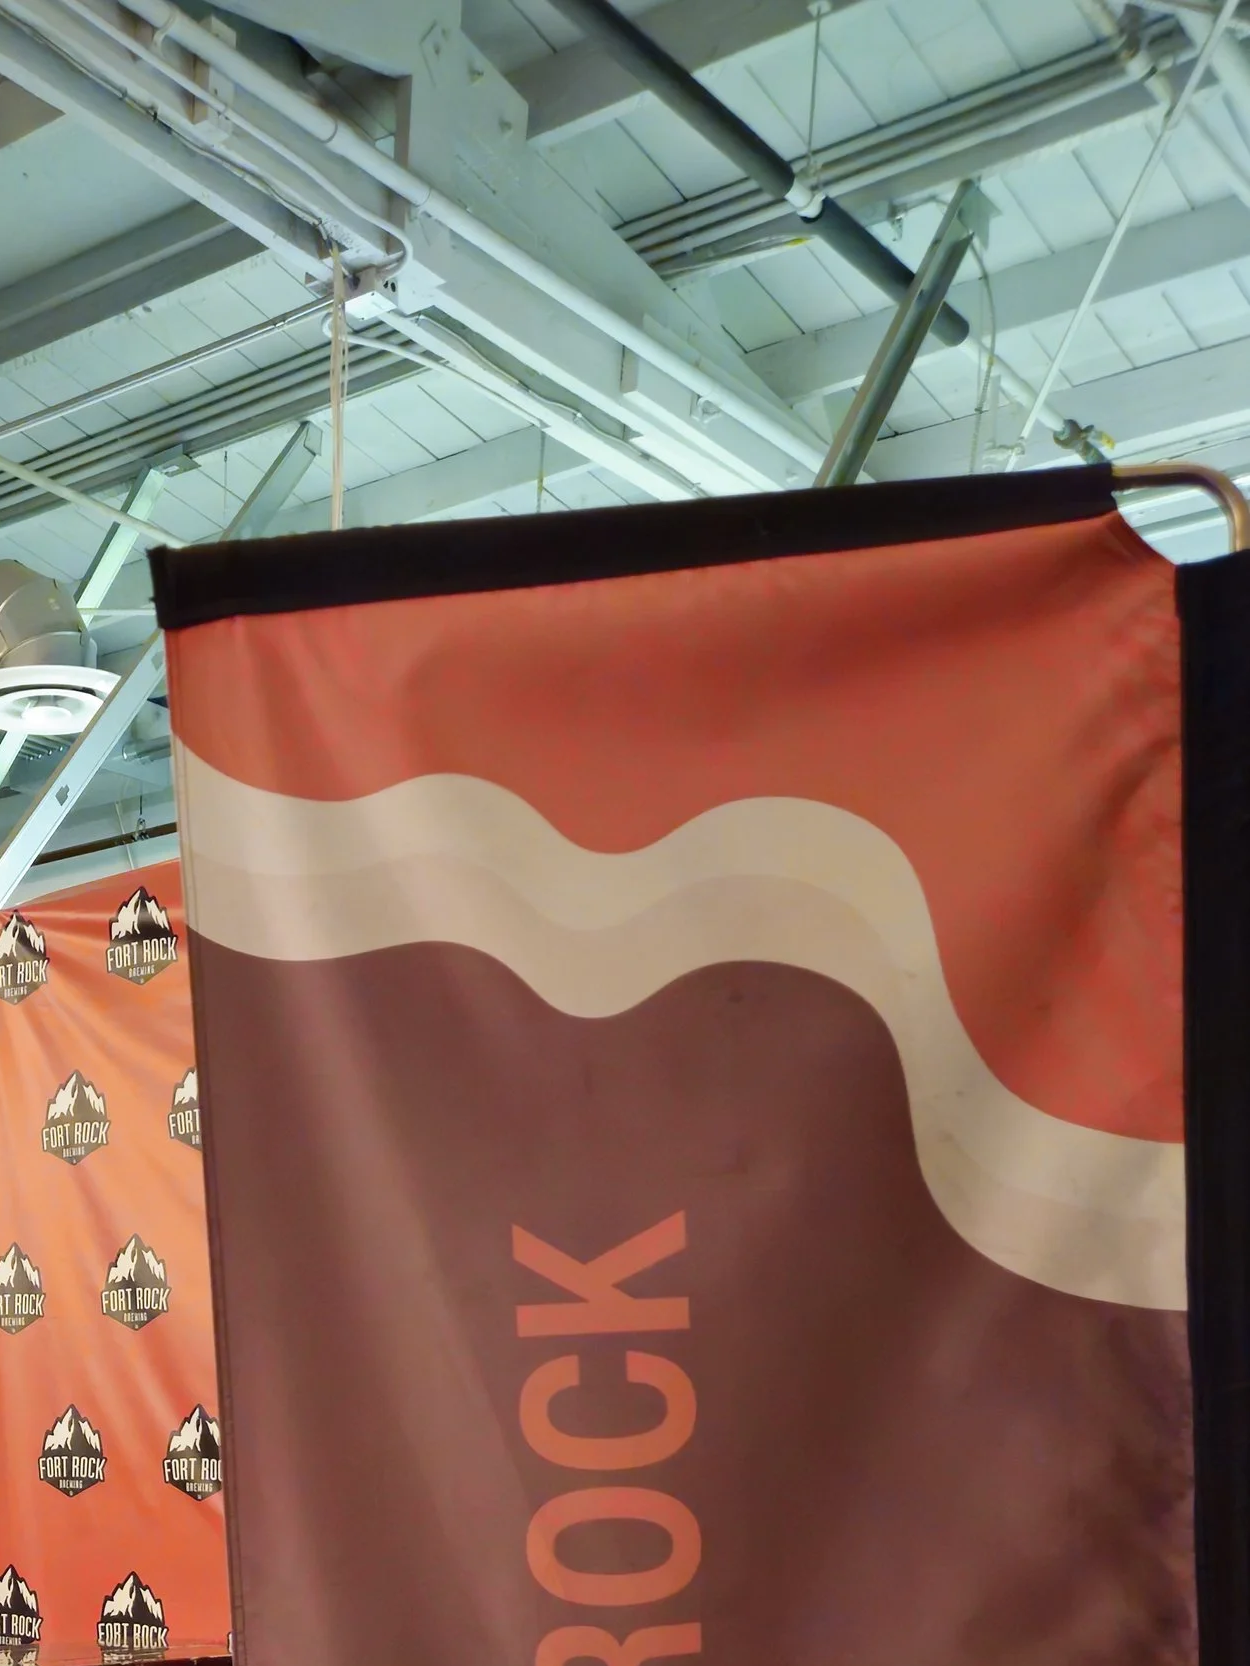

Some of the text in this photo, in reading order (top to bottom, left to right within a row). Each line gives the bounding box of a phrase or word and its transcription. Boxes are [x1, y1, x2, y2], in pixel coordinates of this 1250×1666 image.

[107, 937, 177, 970] FORT ROCK
[16, 959, 49, 985] ROCK
[42, 1120, 111, 1151] FORT ROCK
[168, 1108, 200, 1137] FORT
[14, 1293, 46, 1316] ROCK
[102, 1287, 171, 1313] FORT ROCK
[38, 1456, 107, 1480] FORT ROCK
[164, 1457, 197, 1482] FORT
[11, 1614, 42, 1639] ROCK
